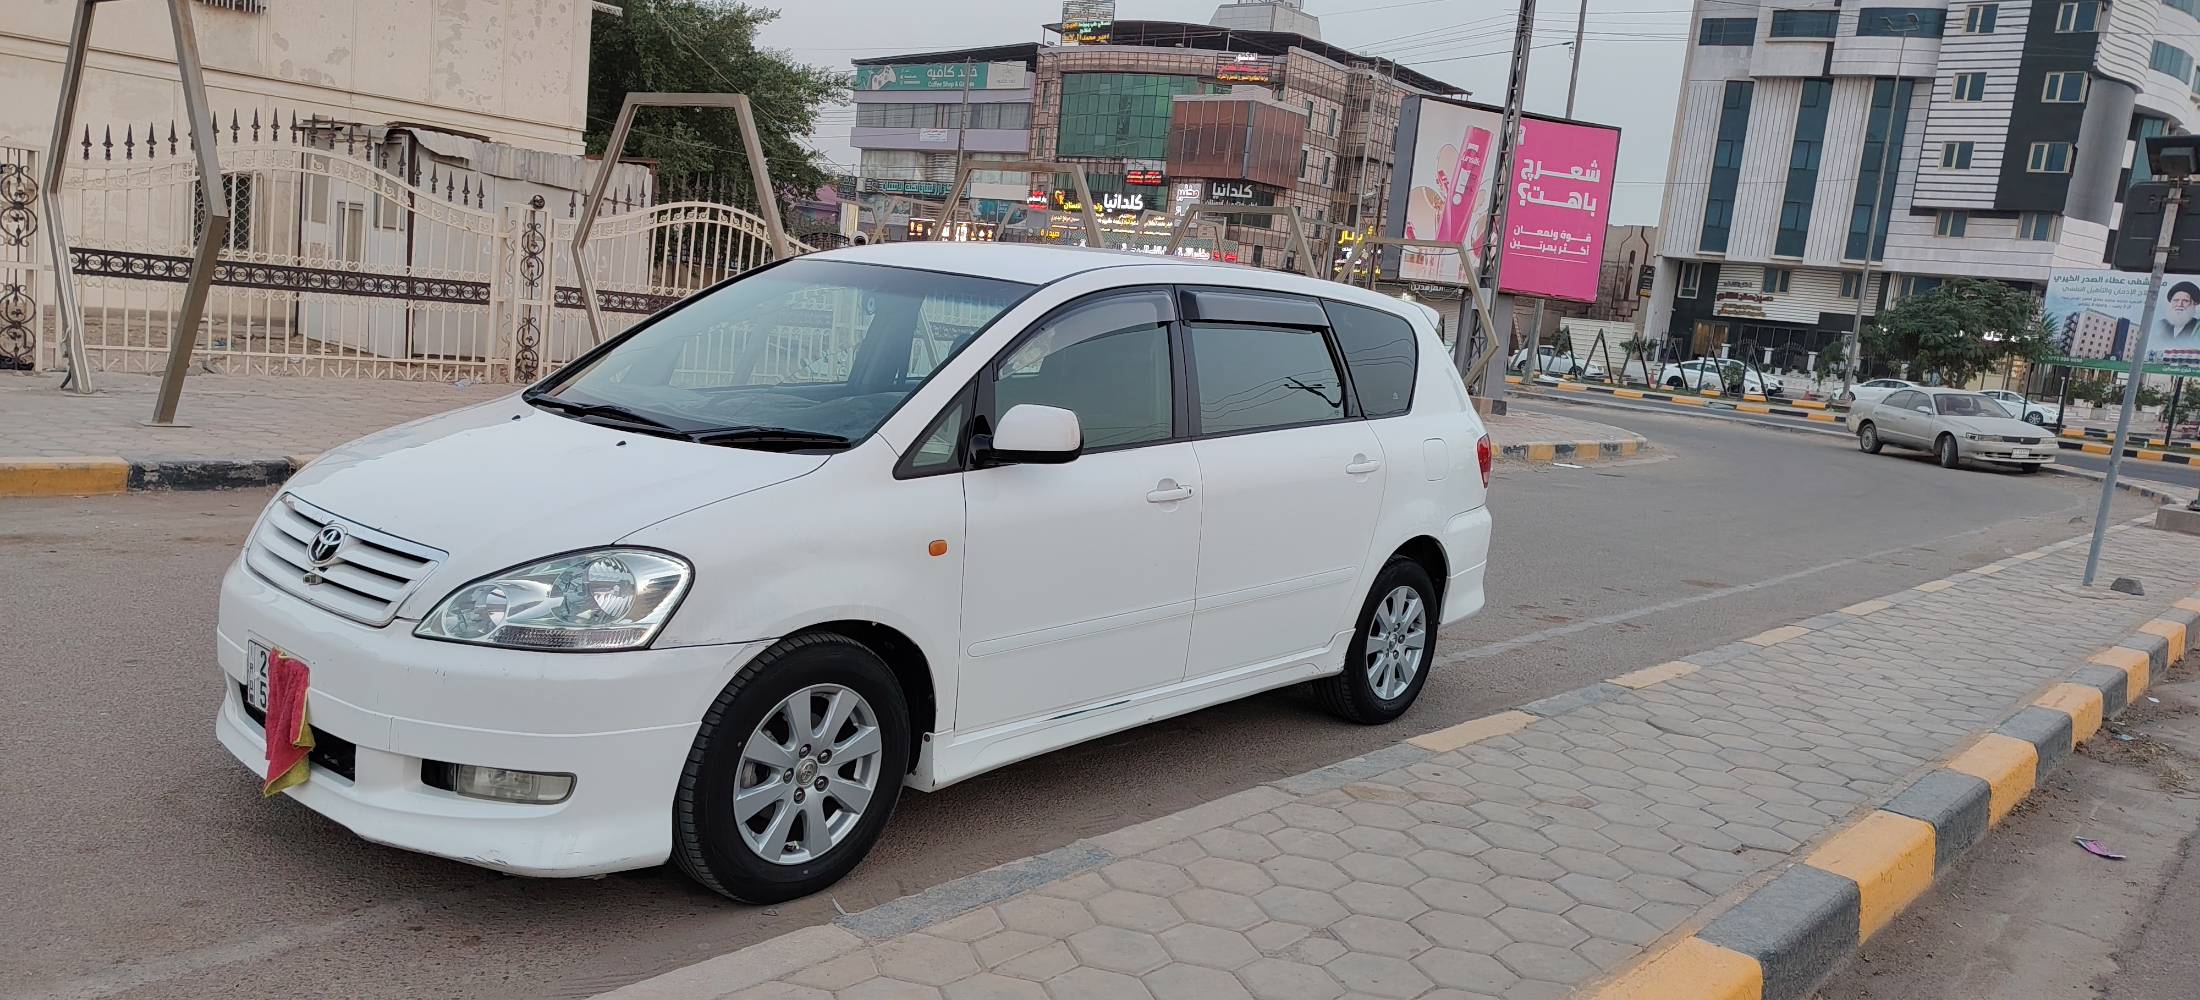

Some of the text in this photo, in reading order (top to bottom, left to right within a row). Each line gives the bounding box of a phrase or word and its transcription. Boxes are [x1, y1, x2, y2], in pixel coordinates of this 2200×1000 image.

[1212, 182, 1254, 199] كلدانيا
[1103, 193, 1144, 213] كلدانيا
[1517, 182, 1597, 217] باهت؟
[1513, 224, 1559, 241] ولمعان
[2053, 275, 2080, 283] الخيري
[2081, 275, 2103, 284] الصدر
[2105, 276, 2126, 285] عطاء
